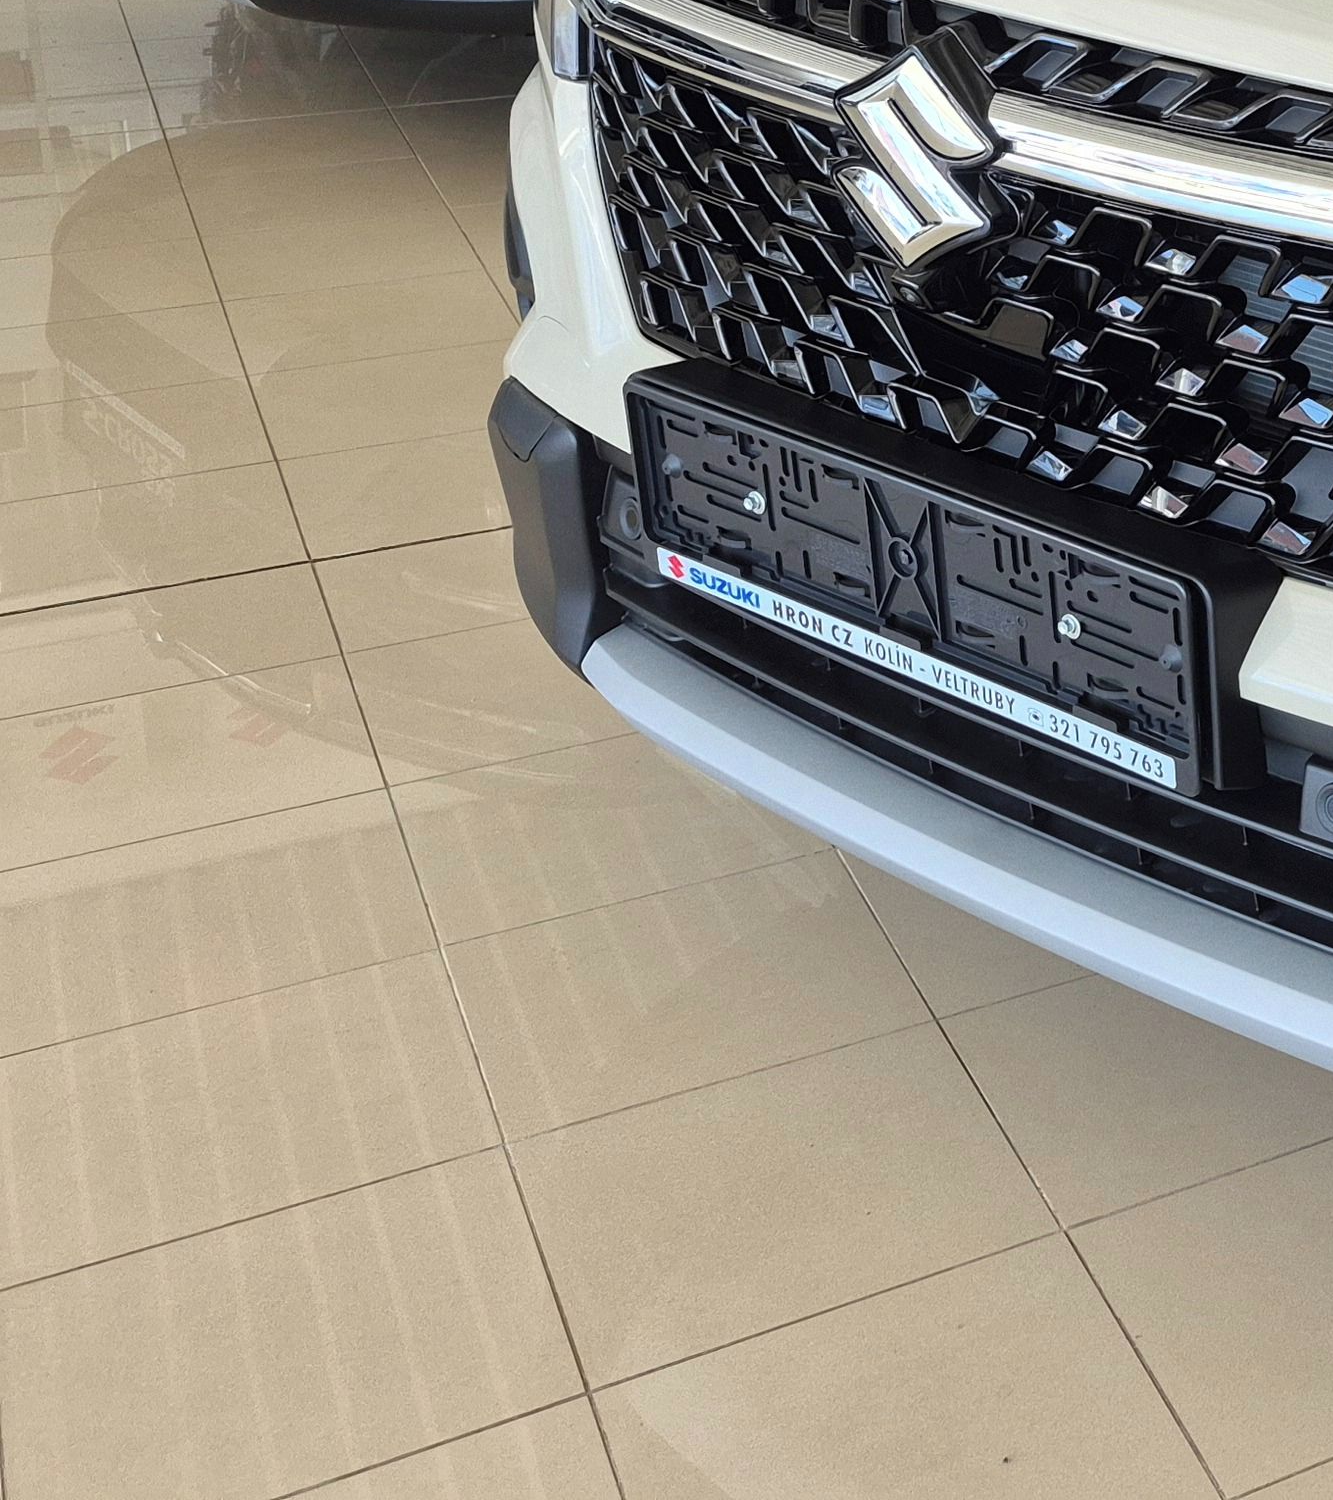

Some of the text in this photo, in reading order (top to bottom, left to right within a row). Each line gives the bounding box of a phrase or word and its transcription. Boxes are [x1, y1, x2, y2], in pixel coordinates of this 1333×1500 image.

[689, 567, 761, 609] SUZUKI
[772, 600, 823, 635] HRON
[831, 625, 853, 648] CZ
[932, 665, 1015, 714] VELTRUBY
[1049, 714, 1080, 742] 321
[1089, 731, 1122, 760] 795
[1130, 748, 1164, 779] 763
